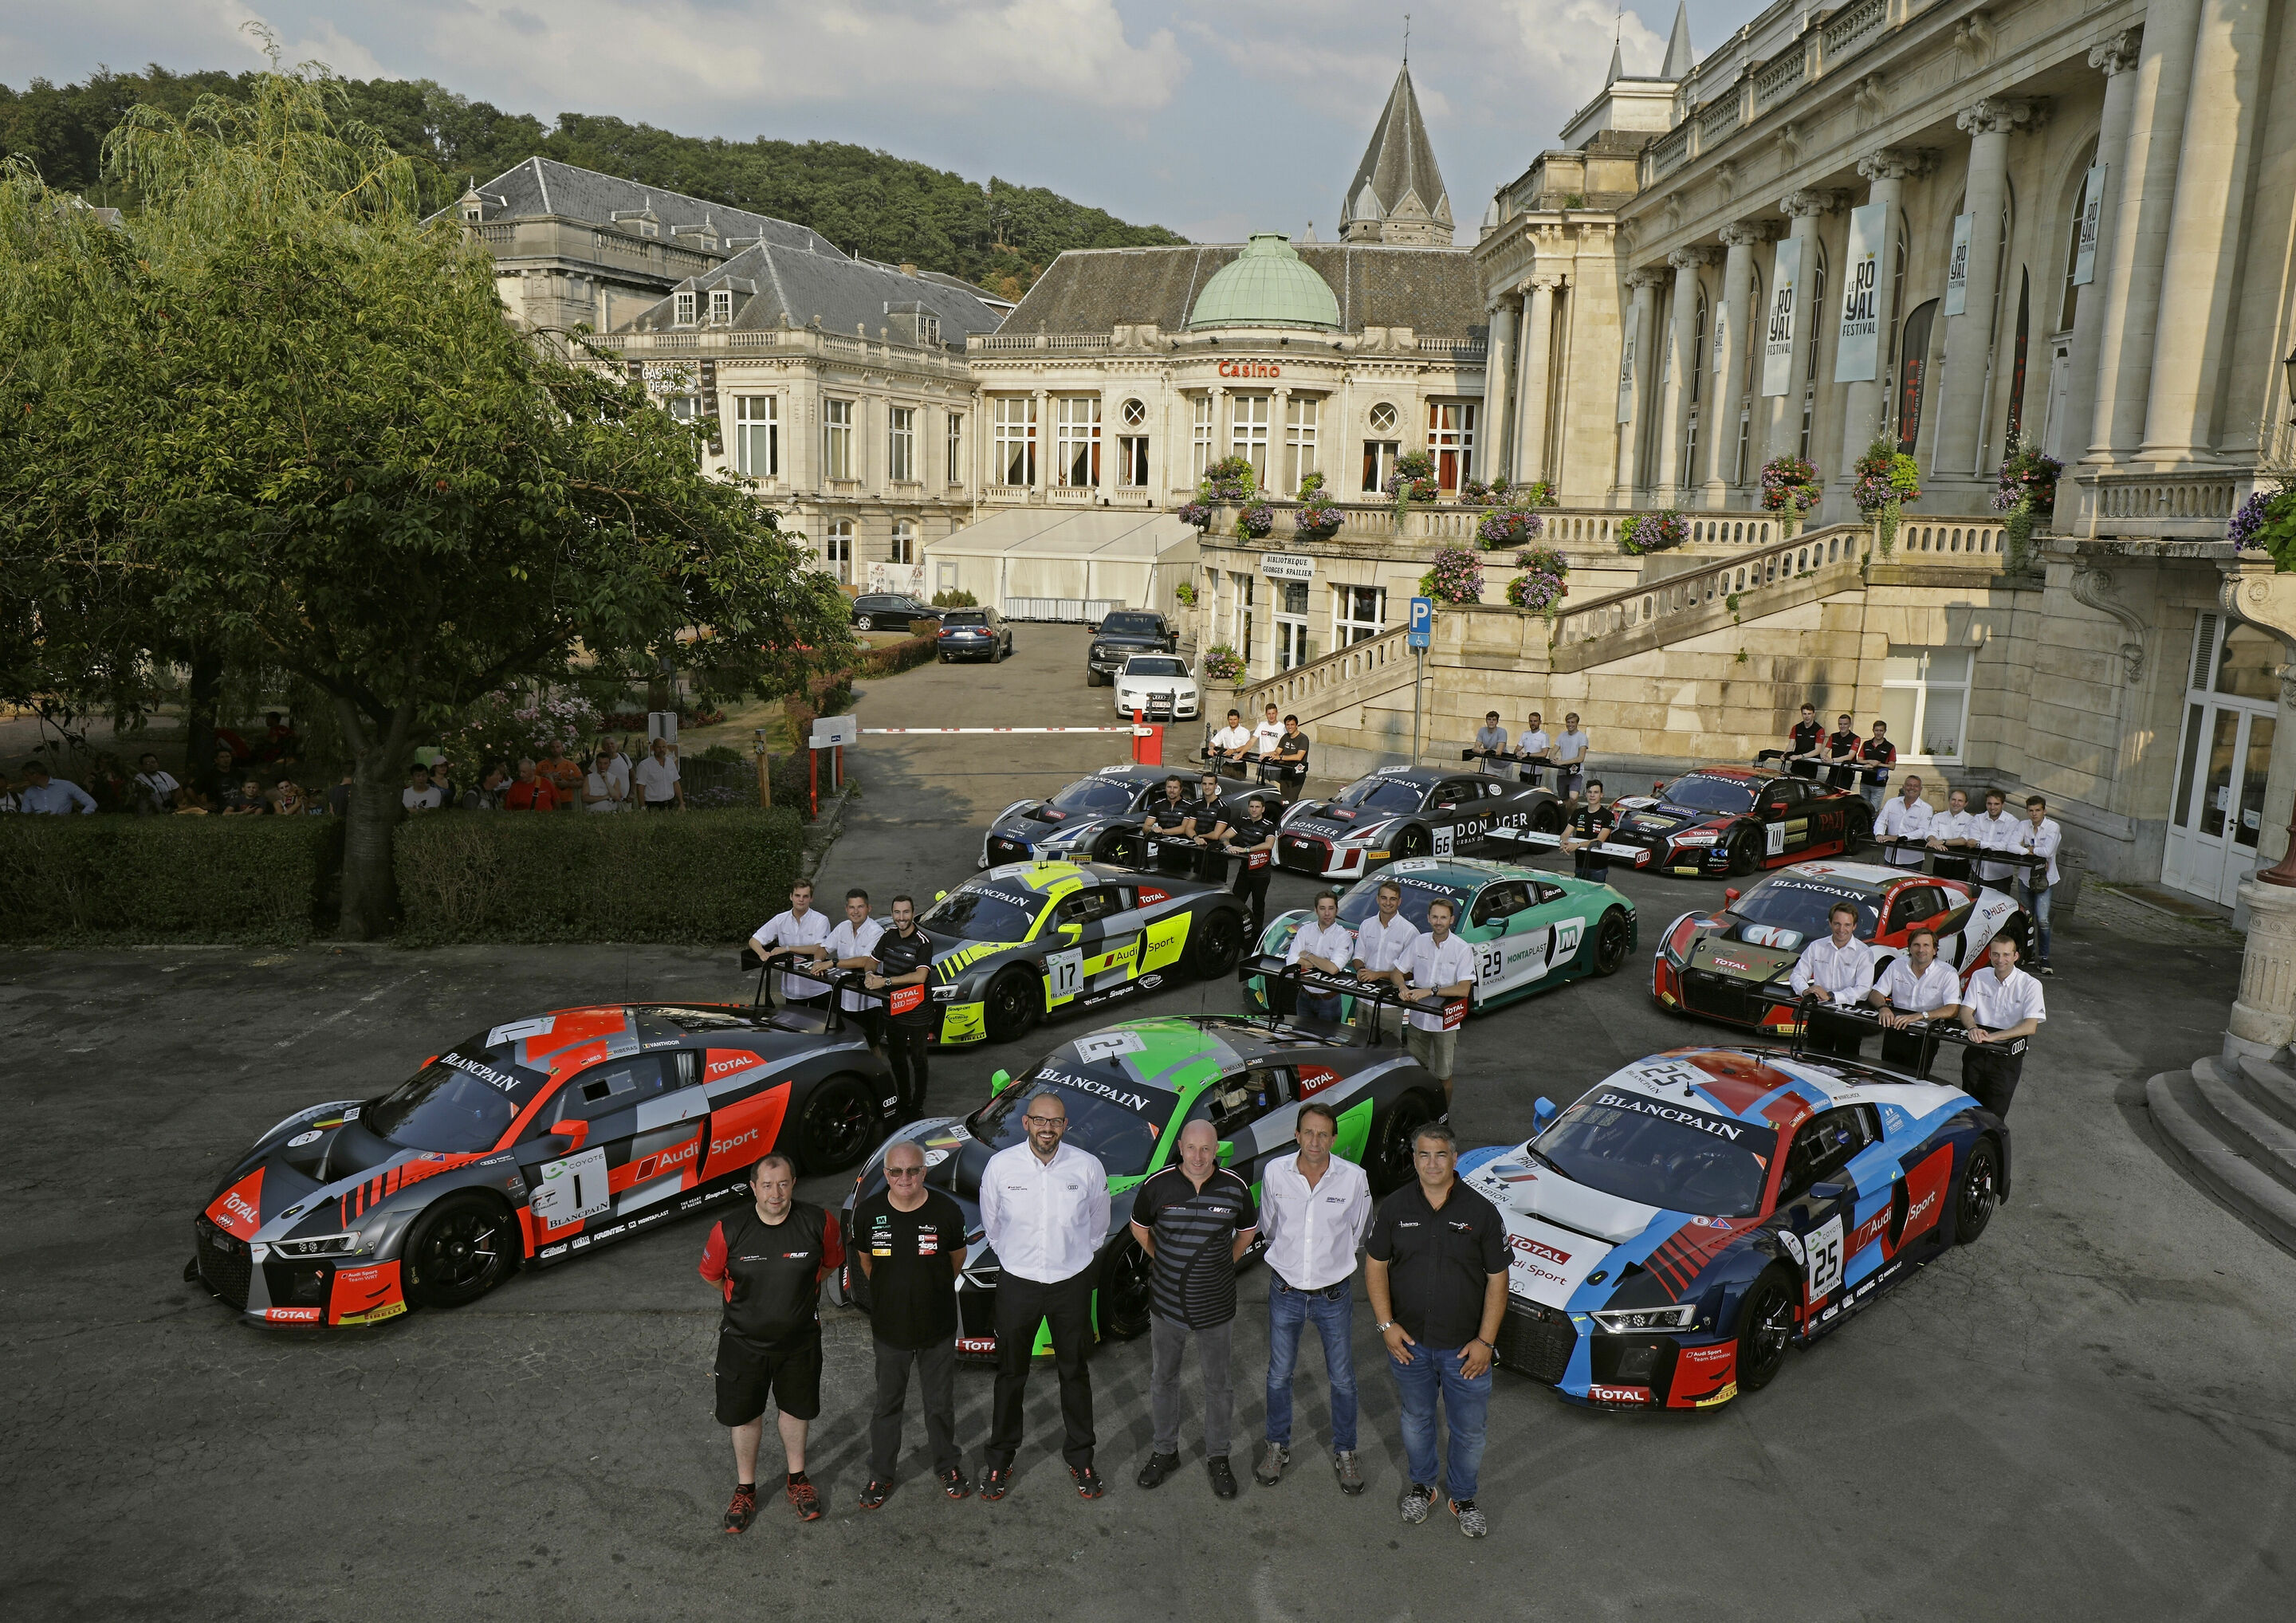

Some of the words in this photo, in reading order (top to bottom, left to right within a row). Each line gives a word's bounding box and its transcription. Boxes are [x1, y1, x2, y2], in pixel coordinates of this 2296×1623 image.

[1948, 280, 1965, 289] FESTIVAL
[1842, 322, 1875, 336] FESTIVAL
[1767, 343, 1791, 356] FESTIVAL
[1218, 361, 1280, 378] Casino
[649, 381, 661, 392] DE
[1267, 556, 1308, 567] BIBLIOTHEQUE
[1262, 565, 1284, 575] GEORGES
[1286, 568, 1312, 577] SPAILIER
[1413, 603, 1429, 628] P
[1083, 776, 1132, 789] BLANCPAIN
[1366, 775, 1421, 789] BLANCPAIN
[1686, 773, 1749, 788] BLANCPAIN
[1661, 805, 1694, 815] RAVENOL
[1290, 821, 1339, 836] DONIGER
[1435, 836, 1450, 855] 66
[1456, 838, 1472, 847] URBAN
[1772, 830, 1782, 847] 111
[1373, 874, 1455, 895] BLANCPAIN
[1770, 880, 1867, 902] BLANCPAIN
[960, 885, 1030, 907] BLANCPAIN
[1140, 893, 1165, 904] TOTAL
[1991, 902, 2008, 917] HUET
[1116, 946, 1138, 961] Audi
[1148, 936, 1174, 953] Sport
[1507, 942, 1547, 964] MONTAPLAST
[1062, 953, 1081, 961] COYOTE
[1482, 950, 1501, 979] 29
[1715, 958, 1748, 970] TOTAL
[1060, 962, 1075, 990] 17
[1304, 970, 1358, 988] Audi
[892, 988, 919, 1001] TOTAL
[1051, 984, 1084, 1000] BLANCPAIN
[1109, 986, 1134, 998] Snap-on
[1445, 1003, 1464, 1016] TOTAL
[1828, 1004, 1879, 1017] Aud
[649, 1039, 680, 1048] VANTHOOR
[961, 1032, 985, 1042] PIRELLI
[613, 1045, 638, 1055] RIBERAS
[1089, 1039, 1124, 1051] 2
[439, 1052, 521, 1093] BLANCPAIN
[709, 1056, 753, 1074] TOTAL
[1227, 1063, 1244, 1072] MÜLLER
[1301, 1072, 1334, 1091] TOTAL
[1626, 1070, 1662, 1094] BLANCPAIN
[1640, 1066, 1693, 1086] 25
[1035, 1067, 1150, 1111] BLANCPAIN
[1595, 1093, 1744, 1141] BLANCPAIN
[1793, 1111, 1807, 1124] HAASE
[953, 1126, 969, 1139] PRO
[659, 1142, 699, 1168] Audi
[711, 1129, 758, 1154] Sport
[568, 1153, 604, 1169] COYOTE
[1516, 1156, 1539, 1169] PRO
[573, 1174, 583, 1209] 1
[705, 1188, 729, 1201] Snap-on
[1461, 1177, 1510, 1204] CHAMPION
[223, 1192, 258, 1224] TOTAL
[687, 1201, 702, 1209] RACING
[549, 1201, 609, 1228] BLANCPAIN
[638, 1210, 669, 1225] MONTAPLAST
[1869, 1206, 1892, 1236] Audi
[1909, 1190, 1936, 1220] Sport
[593, 1224, 626, 1241] KRONTEC
[1822, 1222, 1842, 1240] COYOTE
[572, 1236, 590, 1247] HÖR
[1511, 1236, 1563, 1263] TOTAL
[1814, 1239, 1838, 1290] 25
[1512, 1259, 1527, 1269] di
[1527, 1264, 1567, 1286] Sport
[1857, 1279, 1876, 1298] KRONTEC
[271, 1309, 314, 1319] TOTAL
[364, 1305, 401, 1319] PIRELLI
[962, 1341, 996, 1350] TOTA
[1592, 1388, 1644, 1401] TOTAL
